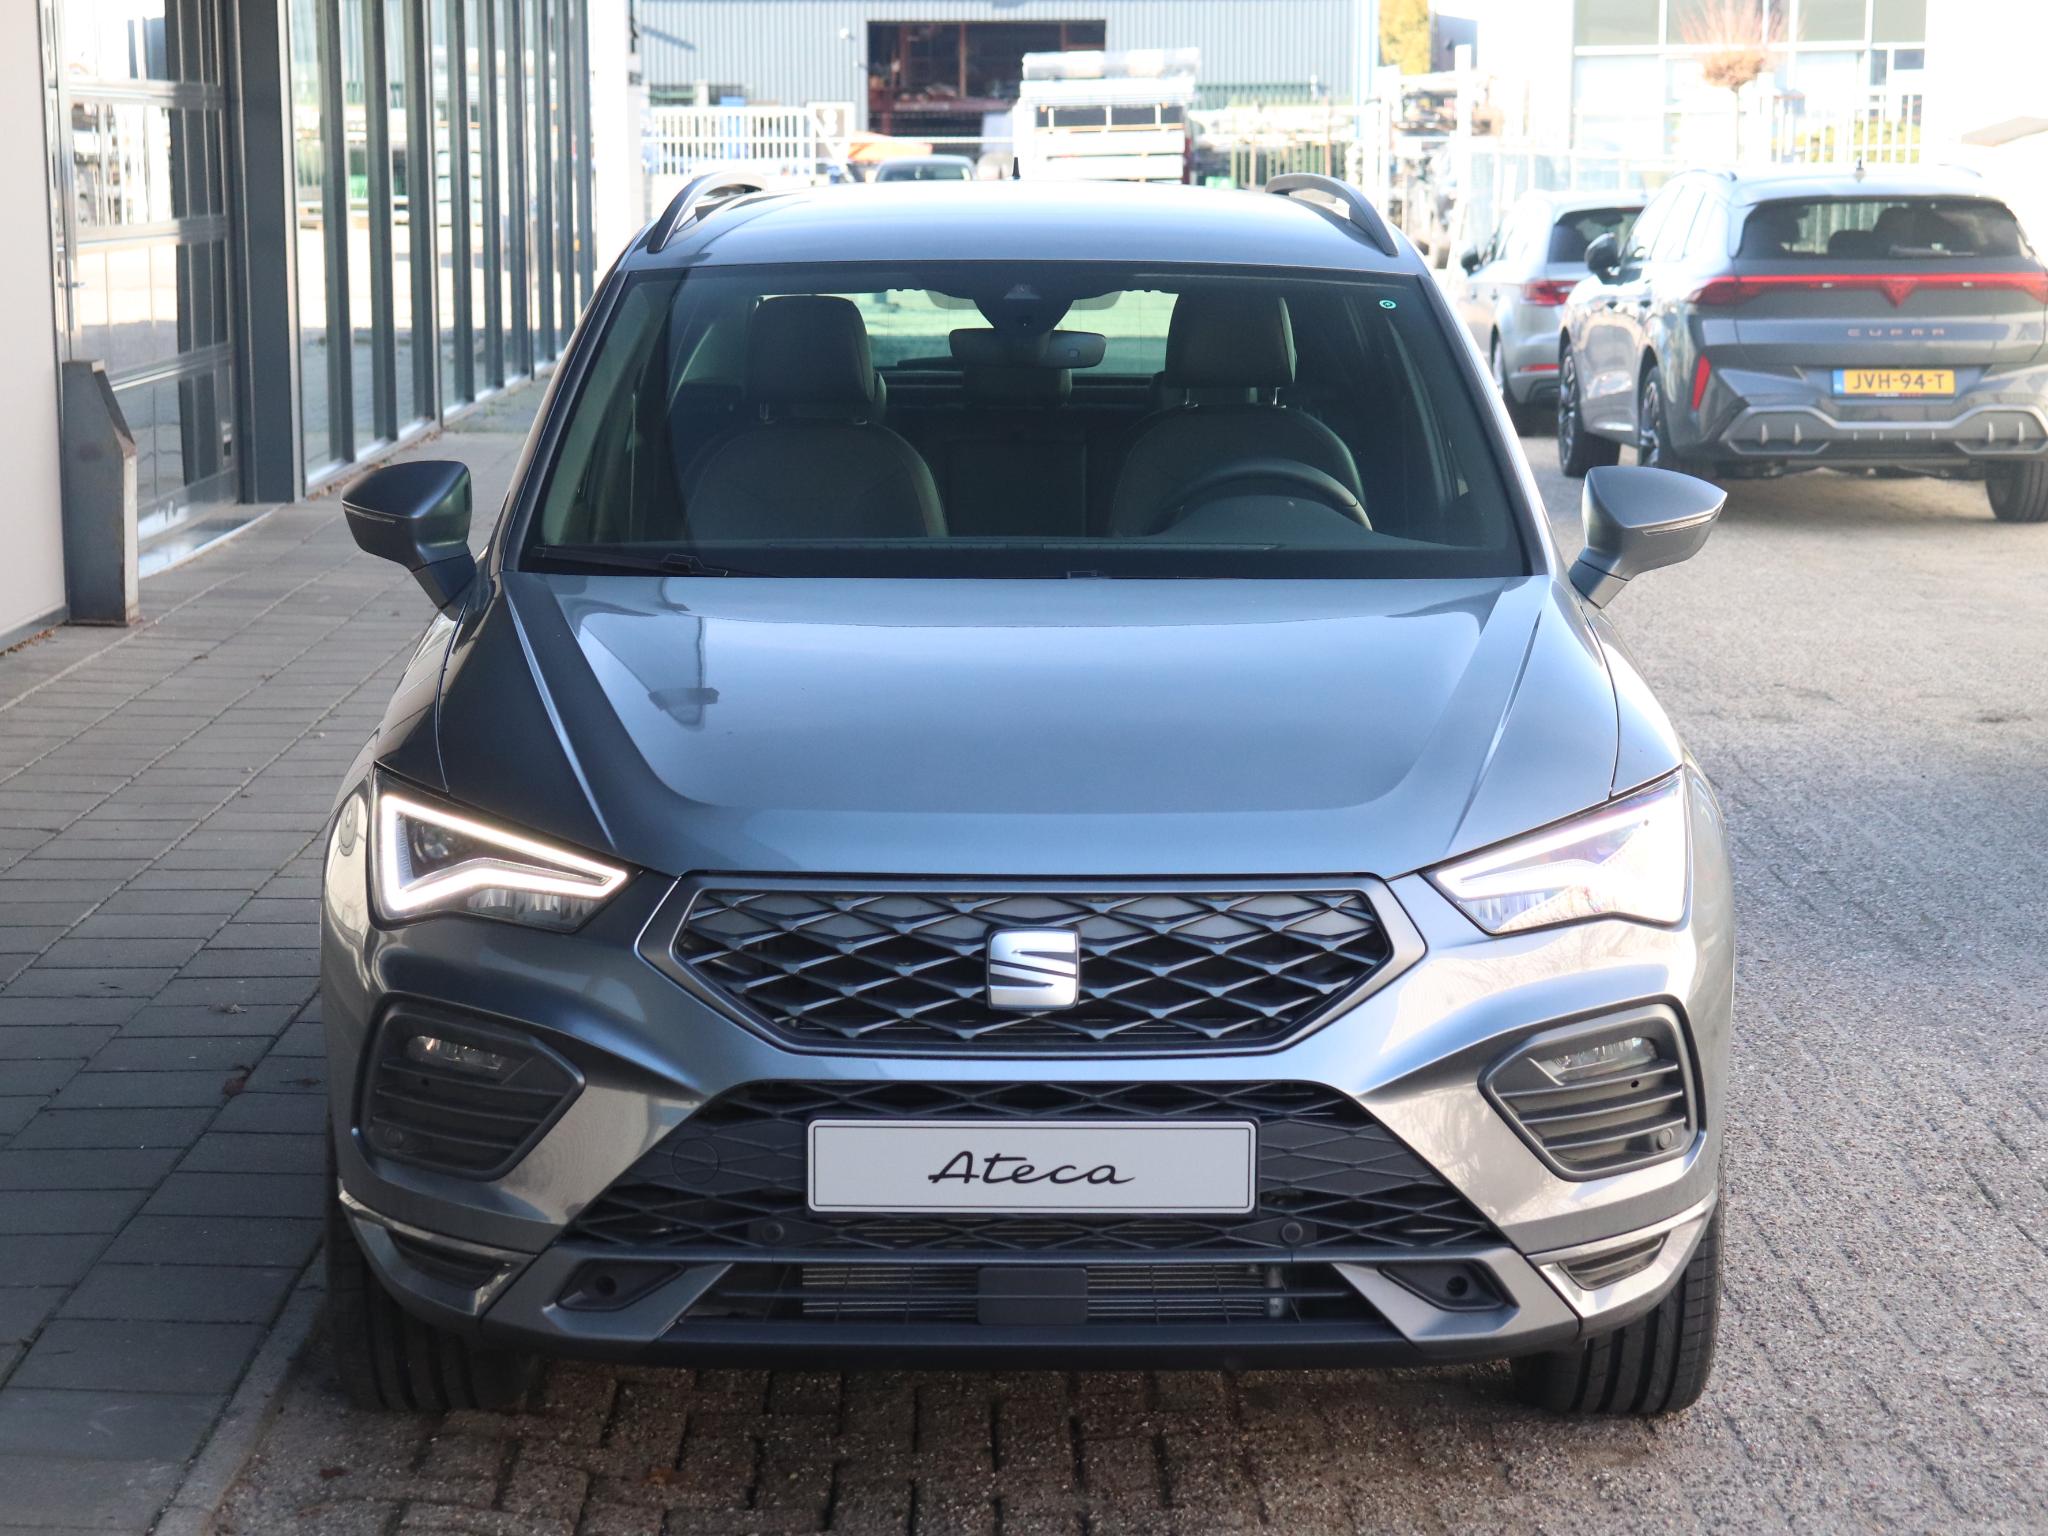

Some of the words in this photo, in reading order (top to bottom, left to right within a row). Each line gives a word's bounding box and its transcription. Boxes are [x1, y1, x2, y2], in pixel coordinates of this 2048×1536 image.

[1847, 328, 1945, 337] CUPRA
[1853, 373, 1945, 390] JVH-94-T
[927, 1150, 1136, 1185] Ateca
